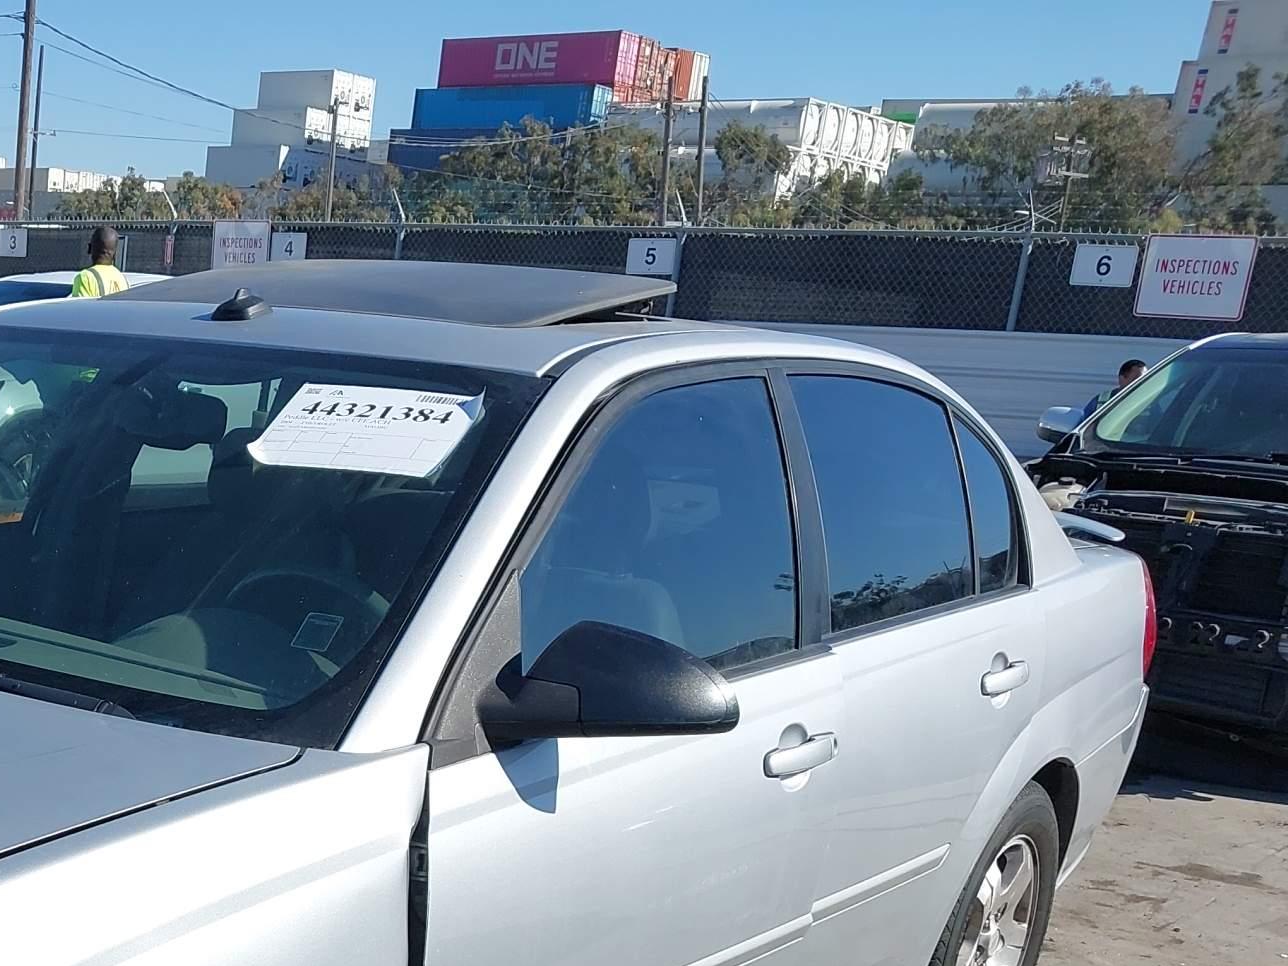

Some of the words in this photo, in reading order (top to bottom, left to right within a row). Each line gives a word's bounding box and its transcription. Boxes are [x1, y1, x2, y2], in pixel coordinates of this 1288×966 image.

[495, 41, 558, 70] ONE
[9, 235, 16, 249] 3
[219, 237, 262, 249] INSPECTIONS
[284, 241, 293, 256] 4
[224, 251, 256, 264] VEHICLES
[644, 247, 656, 265] 5
[1096, 255, 1113, 276] 6
[1155, 258, 1240, 276] INSPECTIONS
[1162, 279, 1223, 296] VEHICLES
[301, 400, 454, 425] 44321384
